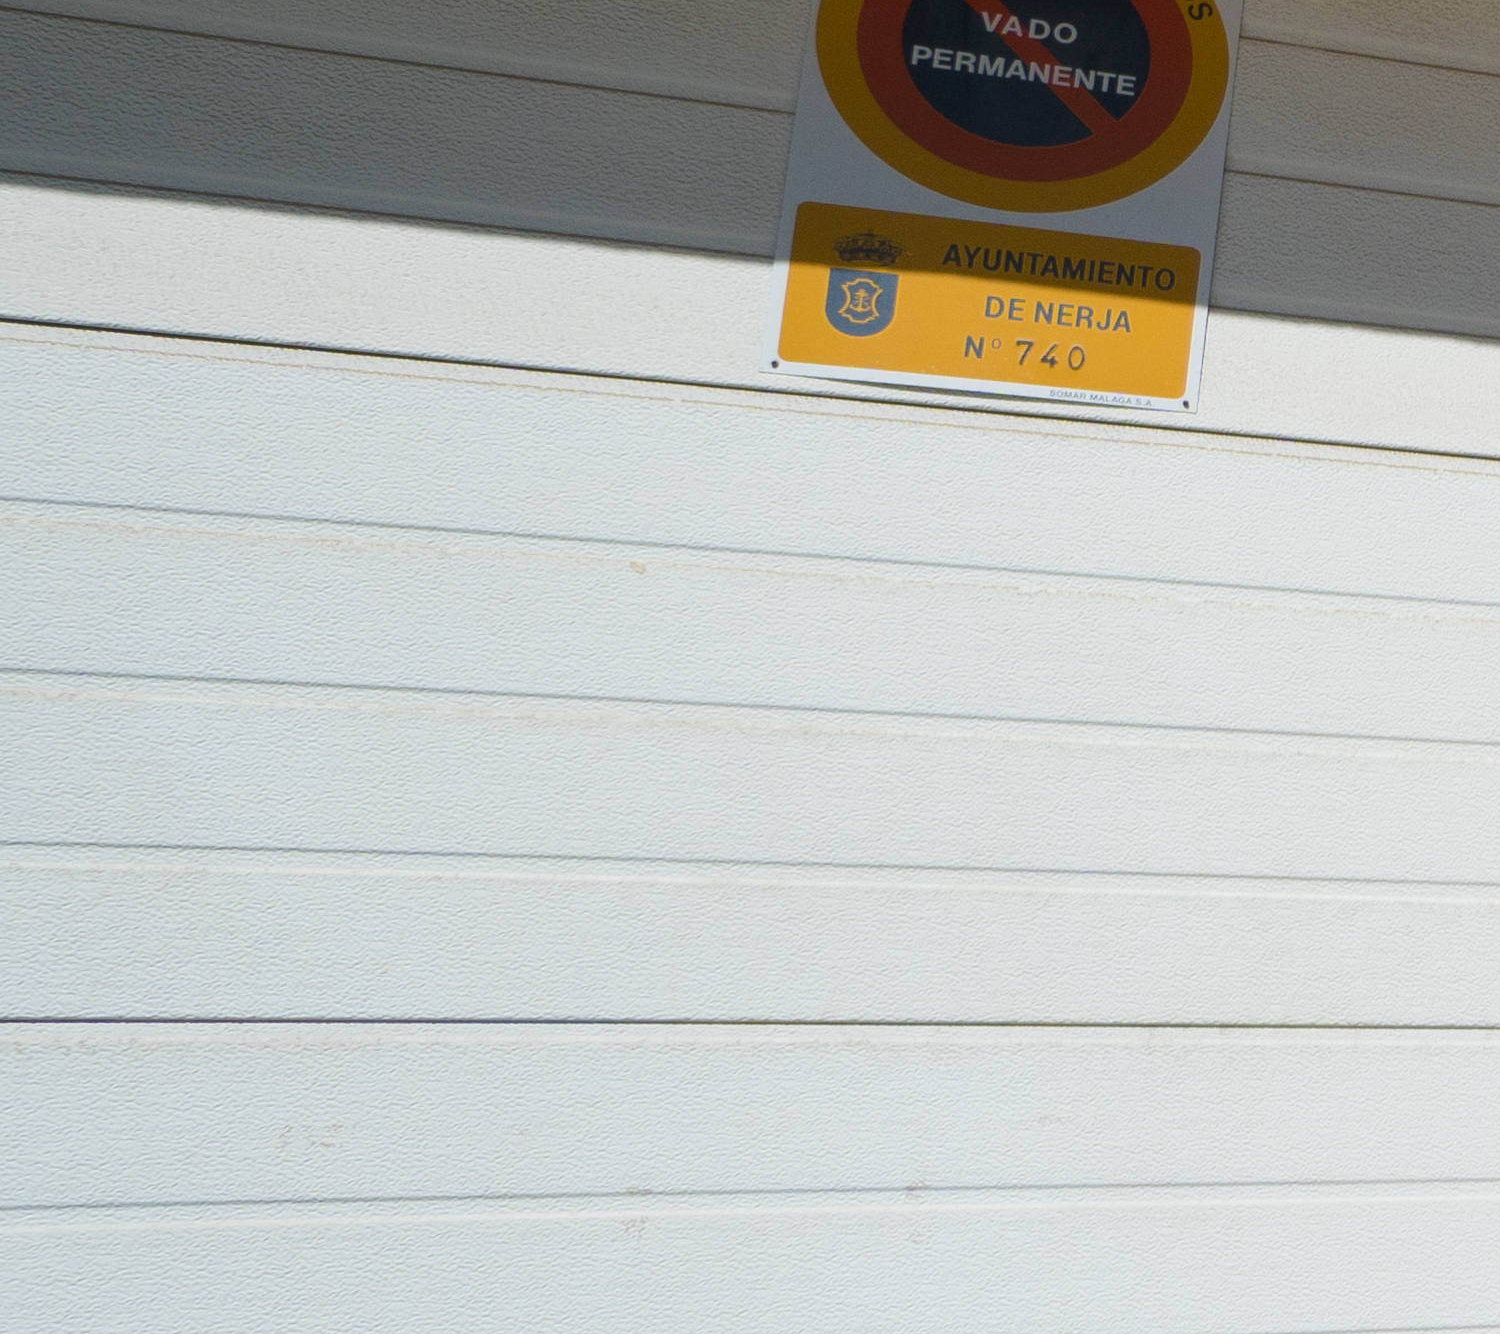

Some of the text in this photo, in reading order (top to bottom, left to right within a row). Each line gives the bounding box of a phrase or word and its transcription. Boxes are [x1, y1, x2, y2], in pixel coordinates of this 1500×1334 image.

[980, 10, 1078, 45] VADO
[910, 44, 1137, 97] PERMANENTE
[941, 243, 1176, 293] AYUNTAMIENTO
[984, 295, 1132, 334] DE NERJA
[1015, 340, 1086, 372] 740
[1048, 388, 1087, 401] SOMAR
[1090, 393, 1133, 406] MALAGA
